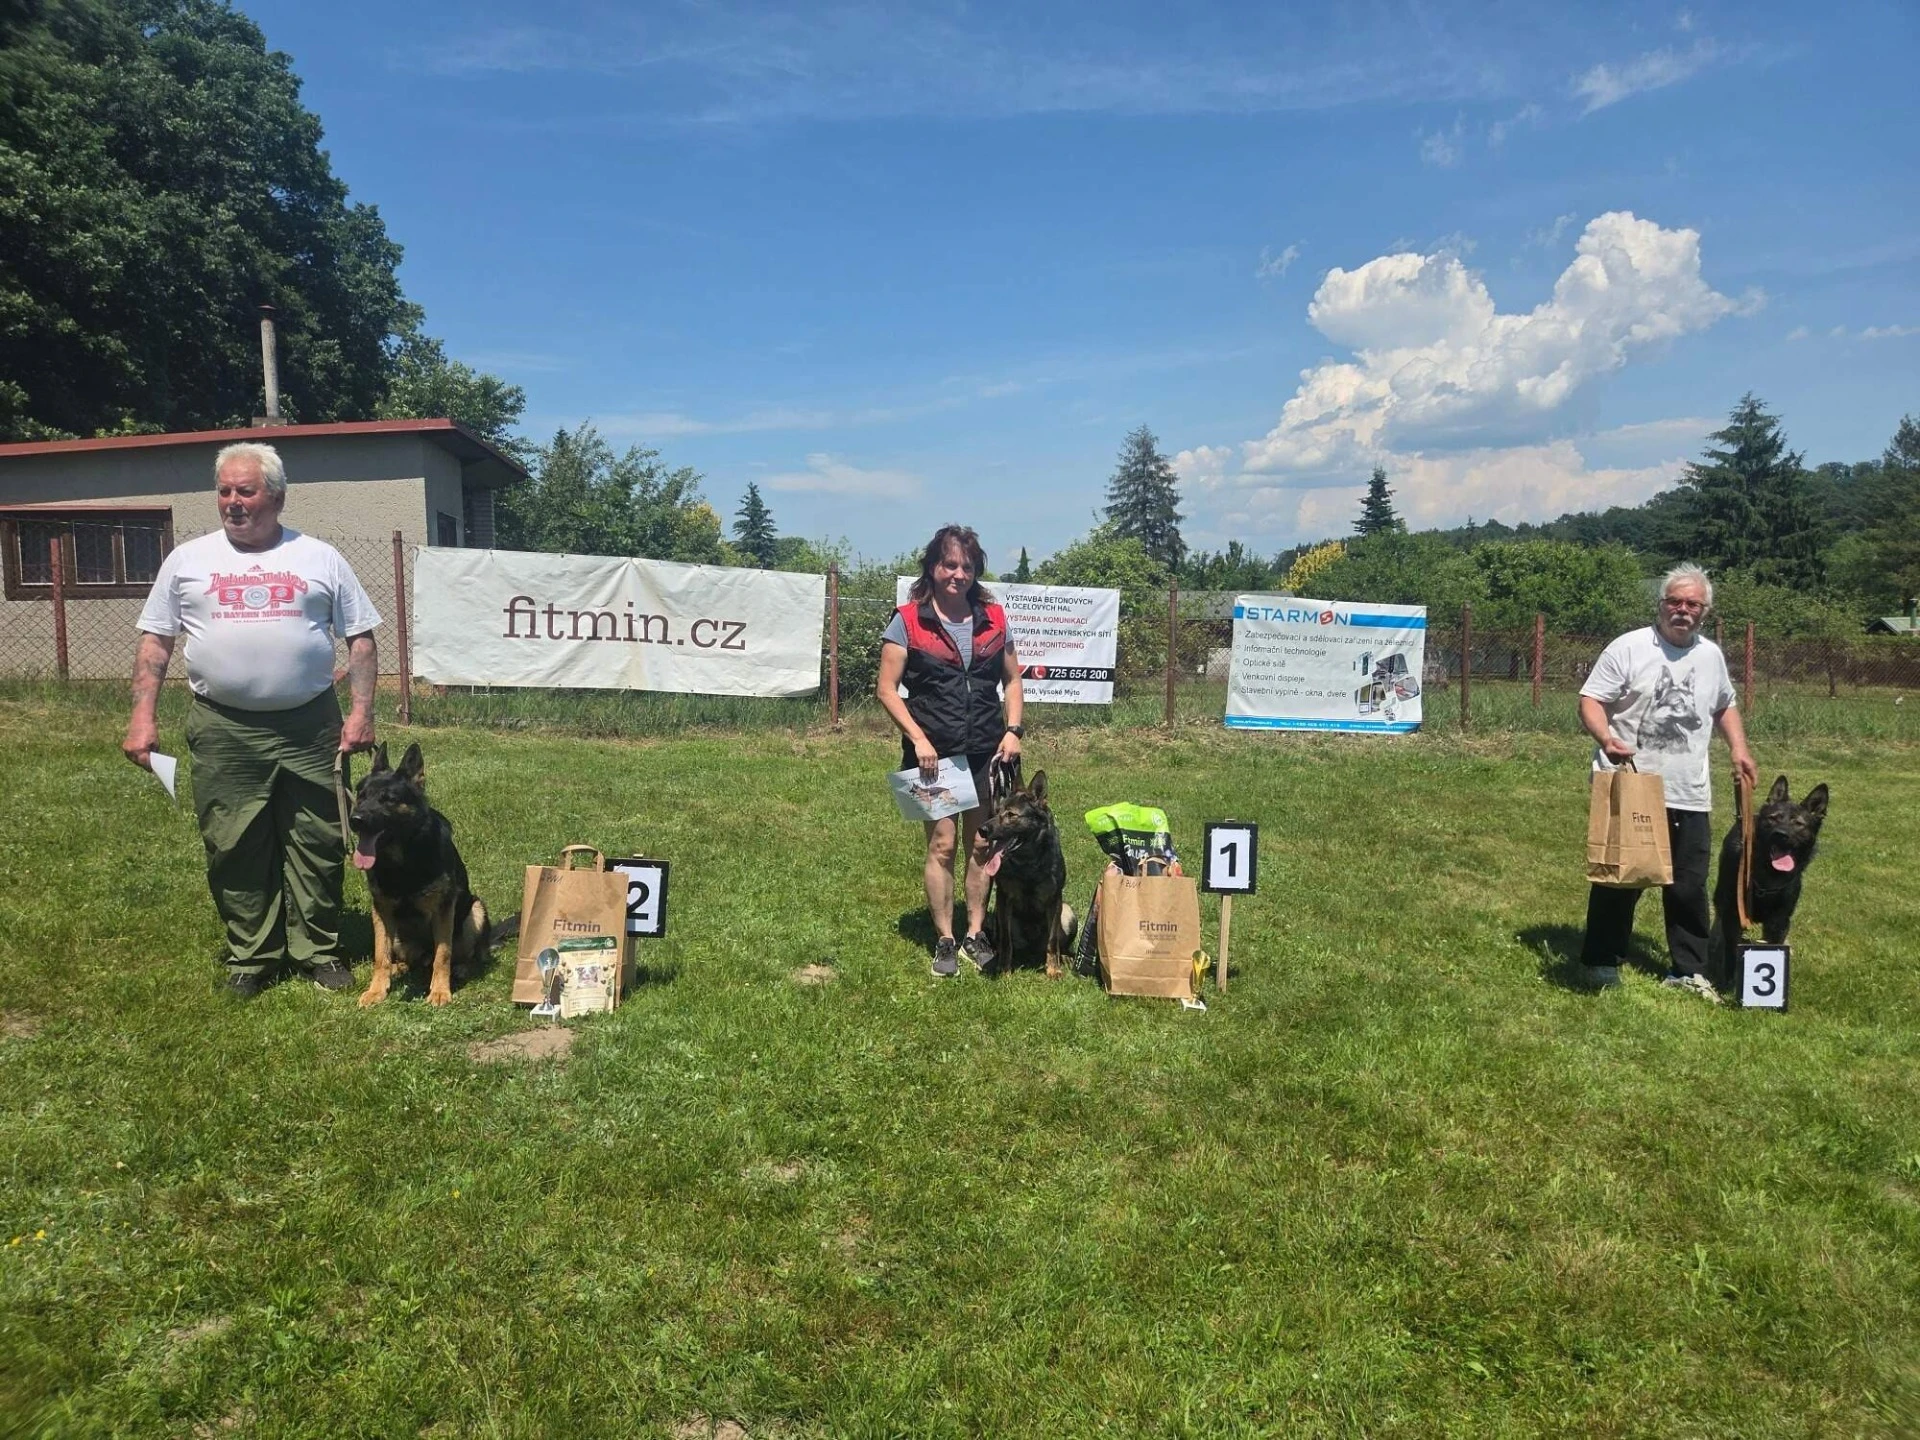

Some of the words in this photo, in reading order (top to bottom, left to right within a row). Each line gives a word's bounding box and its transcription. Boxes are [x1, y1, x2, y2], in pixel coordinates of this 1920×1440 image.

[1057, 604, 1072, 612] HAL
[503, 595, 747, 650] fitmin.cz
[1043, 615, 1088, 625] KOMUNIKACÍ
[1246, 607, 1348, 626] STARMON
[1039, 641, 1085, 649] MONITORING
[1284, 646, 1327, 657] technologie
[1049, 668, 1067, 678] 725
[1069, 669, 1088, 679] 654
[1089, 670, 1108, 680] 200
[1277, 674, 1306, 684] displeje
[1039, 688, 1063, 696] Vysoké
[1122, 834, 1146, 847] Ftmin
[1220, 842, 1238, 878] 1
[627, 881, 650, 921] 2
[553, 918, 601, 933] Fitmin
[1139, 920, 1178, 932] Fitmin
[1752, 963, 1776, 997] 3
